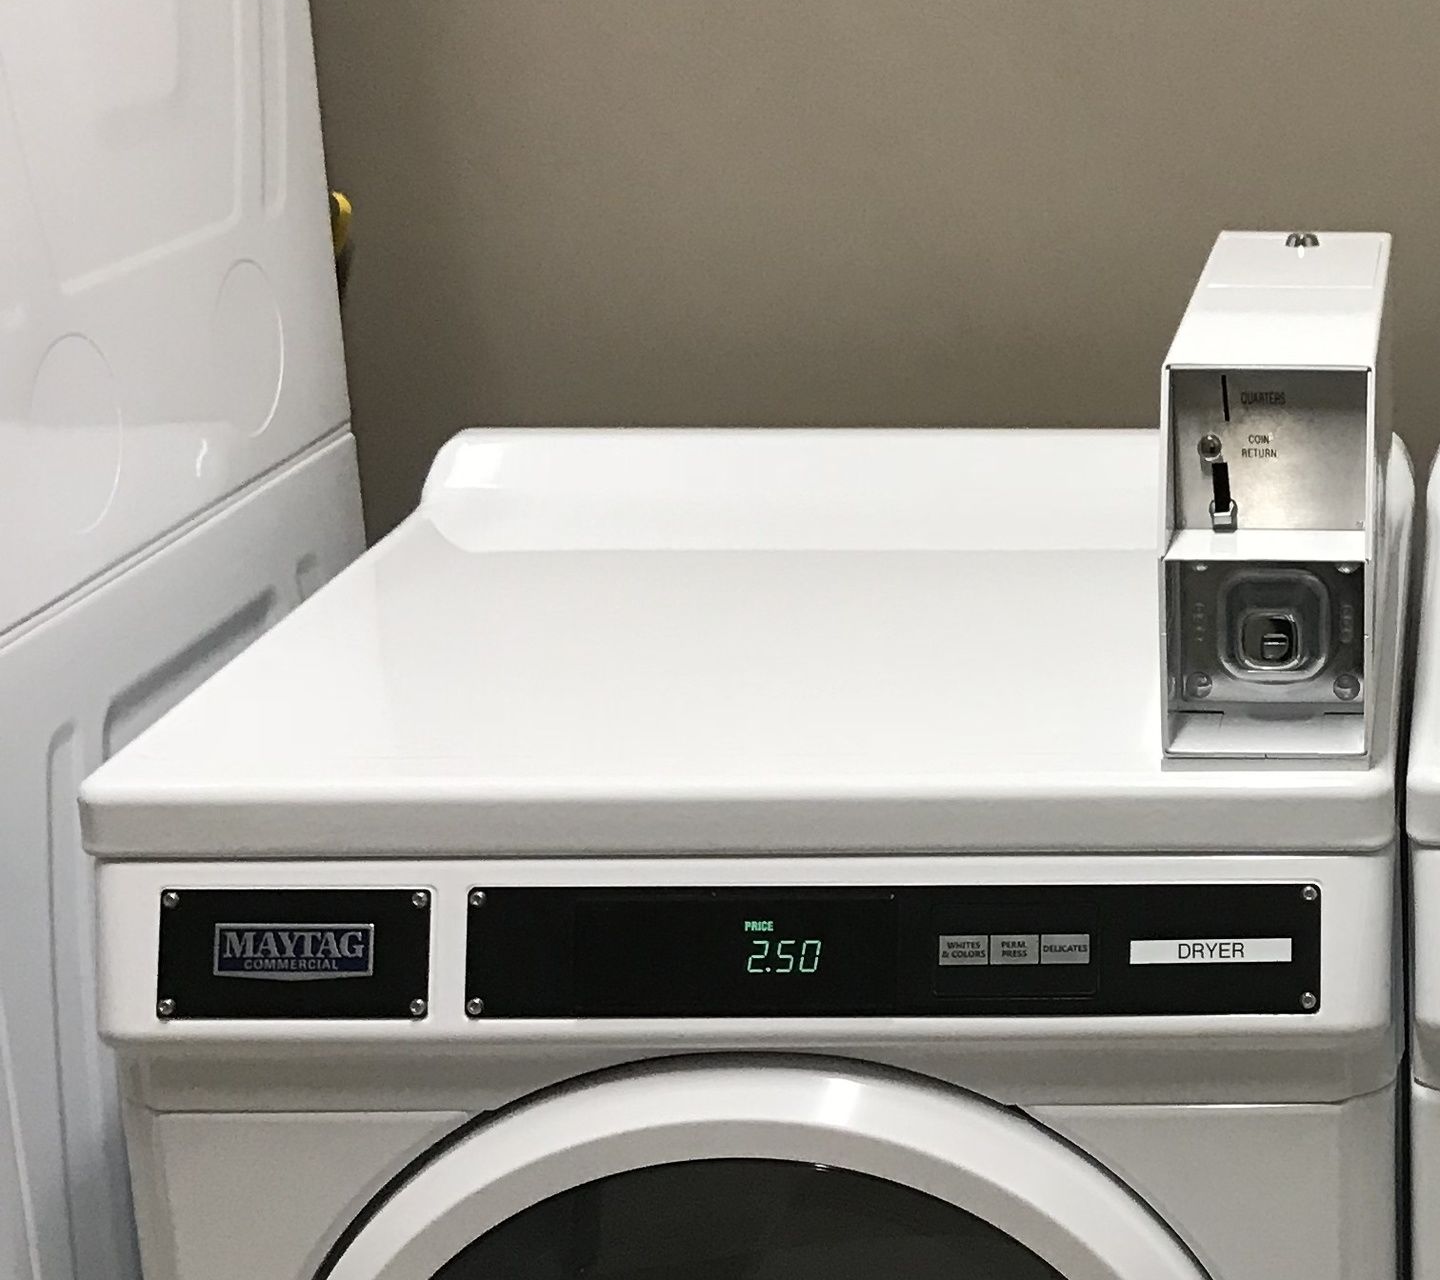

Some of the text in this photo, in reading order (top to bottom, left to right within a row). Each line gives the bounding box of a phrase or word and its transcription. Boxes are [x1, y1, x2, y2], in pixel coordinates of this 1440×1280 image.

[1240, 391, 1286, 405] QUARTERS
[1248, 434, 1270, 444] COIN
[1241, 448, 1277, 458] RETURN
[744, 921, 774, 932] PRICE
[223, 931, 365, 958] MAYTAG
[947, 941, 981, 949] WHITES
[1043, 944, 1088, 953] DELICATES
[951, 949, 986, 958] COLORS
[1002, 950, 1028, 958] PRESS
[1178, 942, 1244, 959] DRYER
[747, 940, 822, 973] 2.50
[244, 959, 339, 970] COMMERCIAL
